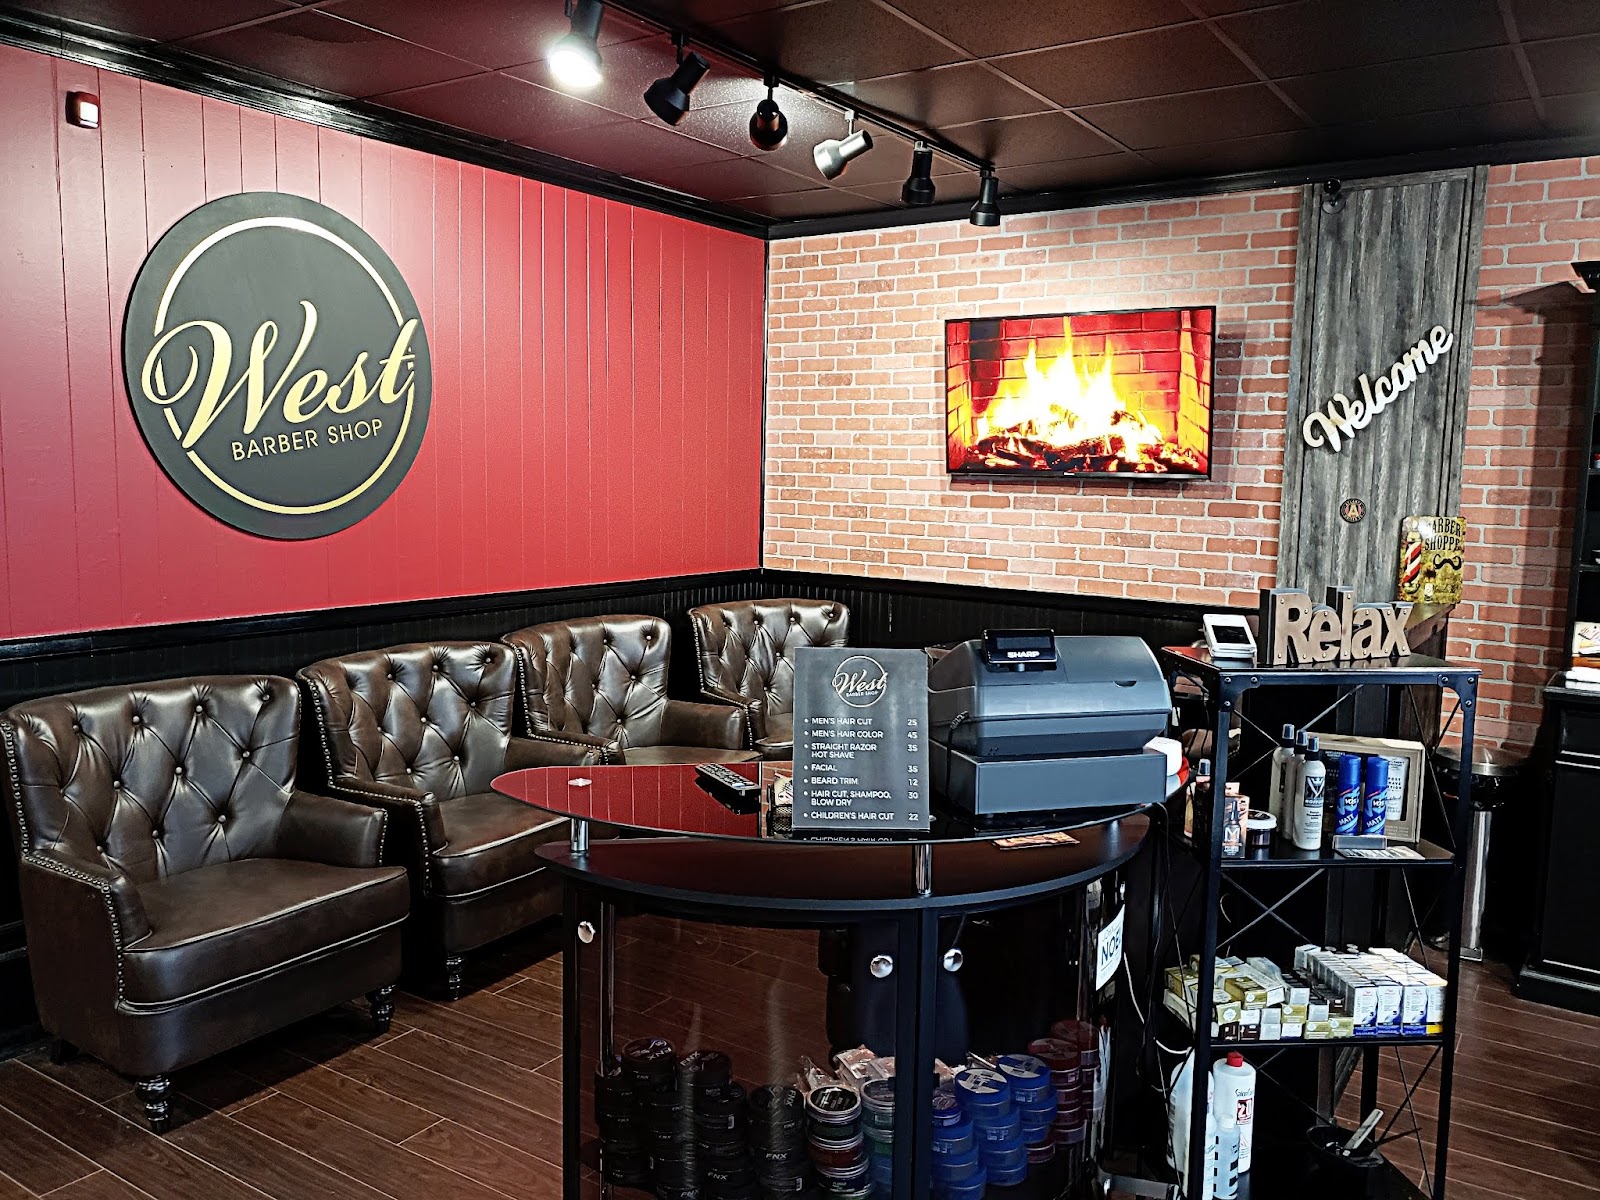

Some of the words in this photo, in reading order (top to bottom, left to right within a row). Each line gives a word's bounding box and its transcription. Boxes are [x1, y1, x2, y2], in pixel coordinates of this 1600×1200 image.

[141, 300, 419, 449] West
[1302, 325, 1454, 452] Welcome
[231, 429, 319, 461] BARBER
[328, 418, 383, 445] SHOP
[1428, 518, 1461, 537] ARBER
[1267, 587, 1415, 665] Relax
[1007, 651, 1040, 659] SHARP
[832, 669, 889, 694] West
[811, 717, 836, 725] MEN'S
[856, 718, 873, 726] CUT
[811, 730, 836, 738] MEN'S
[837, 730, 854, 738] HAIR
[856, 731, 884, 739] COLOR
[811, 743, 848, 751] STRAIGHT
[907, 744, 918, 752] 35
[829, 751, 855, 759] SHAVE
[840, 777, 858, 785] TRIM
[811, 790, 830, 798] HAIR
[851, 791, 892, 799] SHAMPOO,
[810, 812, 857, 820] CHILDREN'S
[858, 812, 877, 820] HAIR
[1338, 813, 1355, 826] MATT
[1366, 815, 1383, 828] MATT
[680, 1051, 700, 1067] FNX
[785, 1089, 797, 1107] FNX
[766, 1152, 788, 1160] FNX
[707, 1171, 729, 1181] FNX
